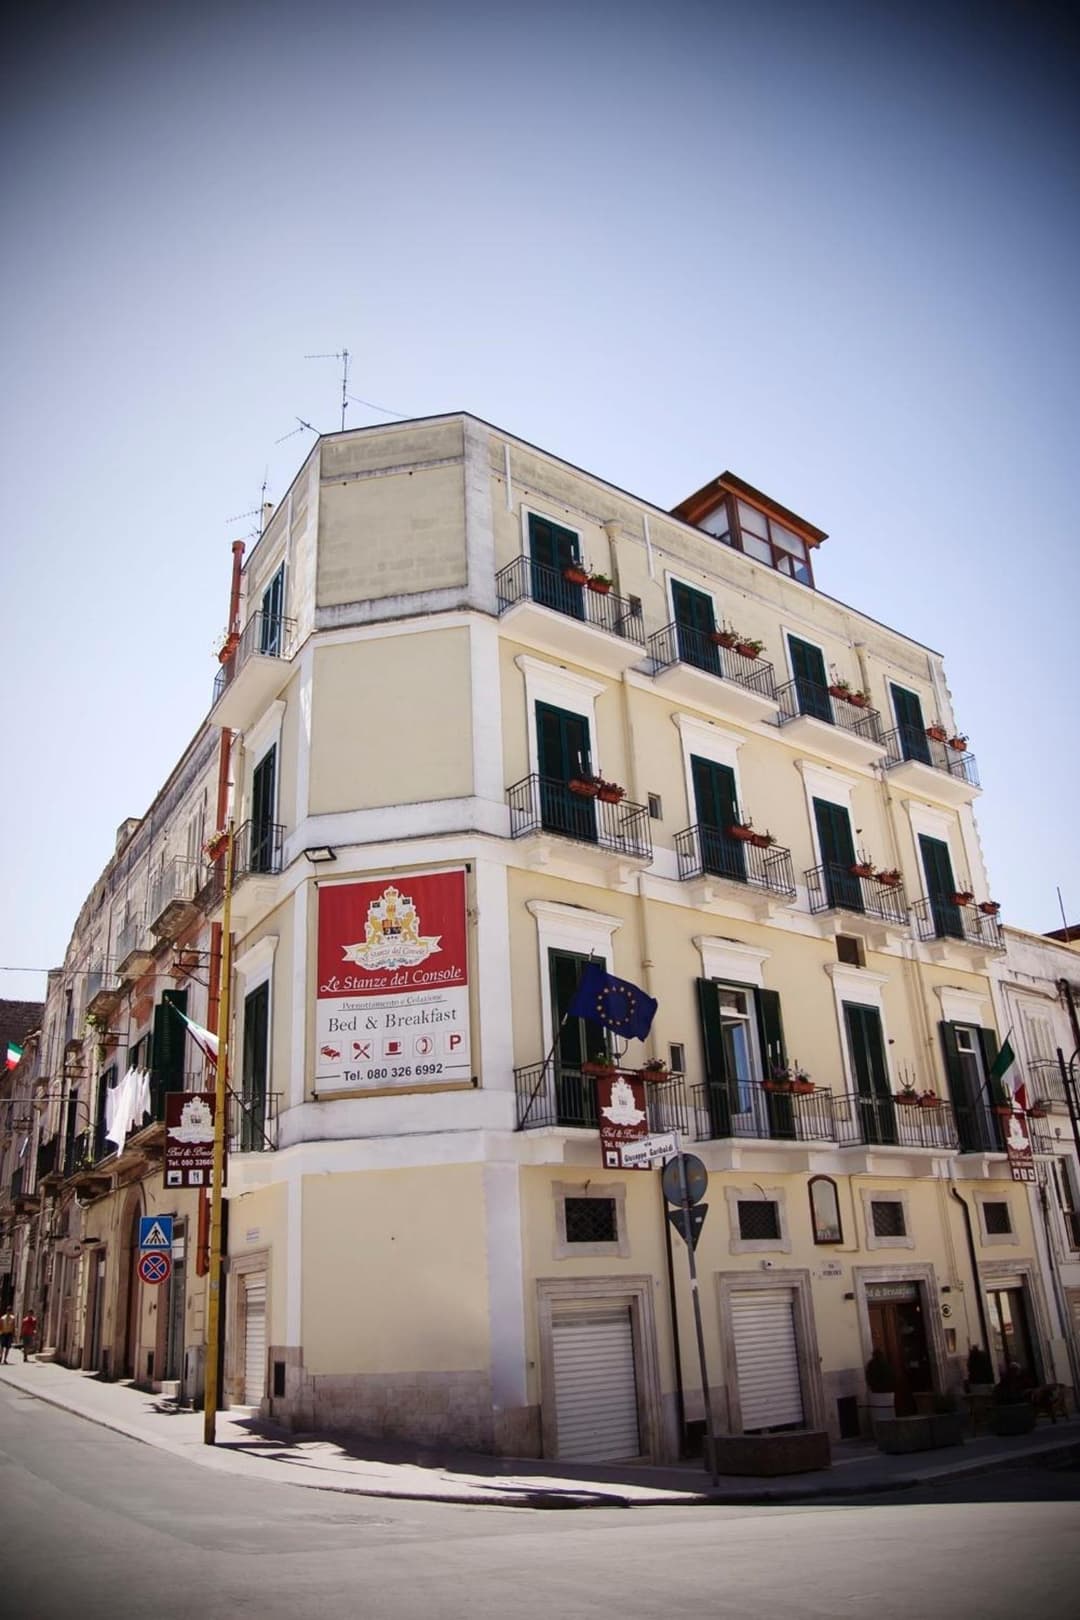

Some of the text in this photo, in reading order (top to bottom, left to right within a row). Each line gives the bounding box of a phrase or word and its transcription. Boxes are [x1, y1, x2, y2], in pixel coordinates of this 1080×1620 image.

[320, 966, 462, 992] Le Stanze del Console
[328, 1008, 457, 1032] Bed & Breakfast
[344, 1063, 443, 1081] Tel. 080 326 6992
